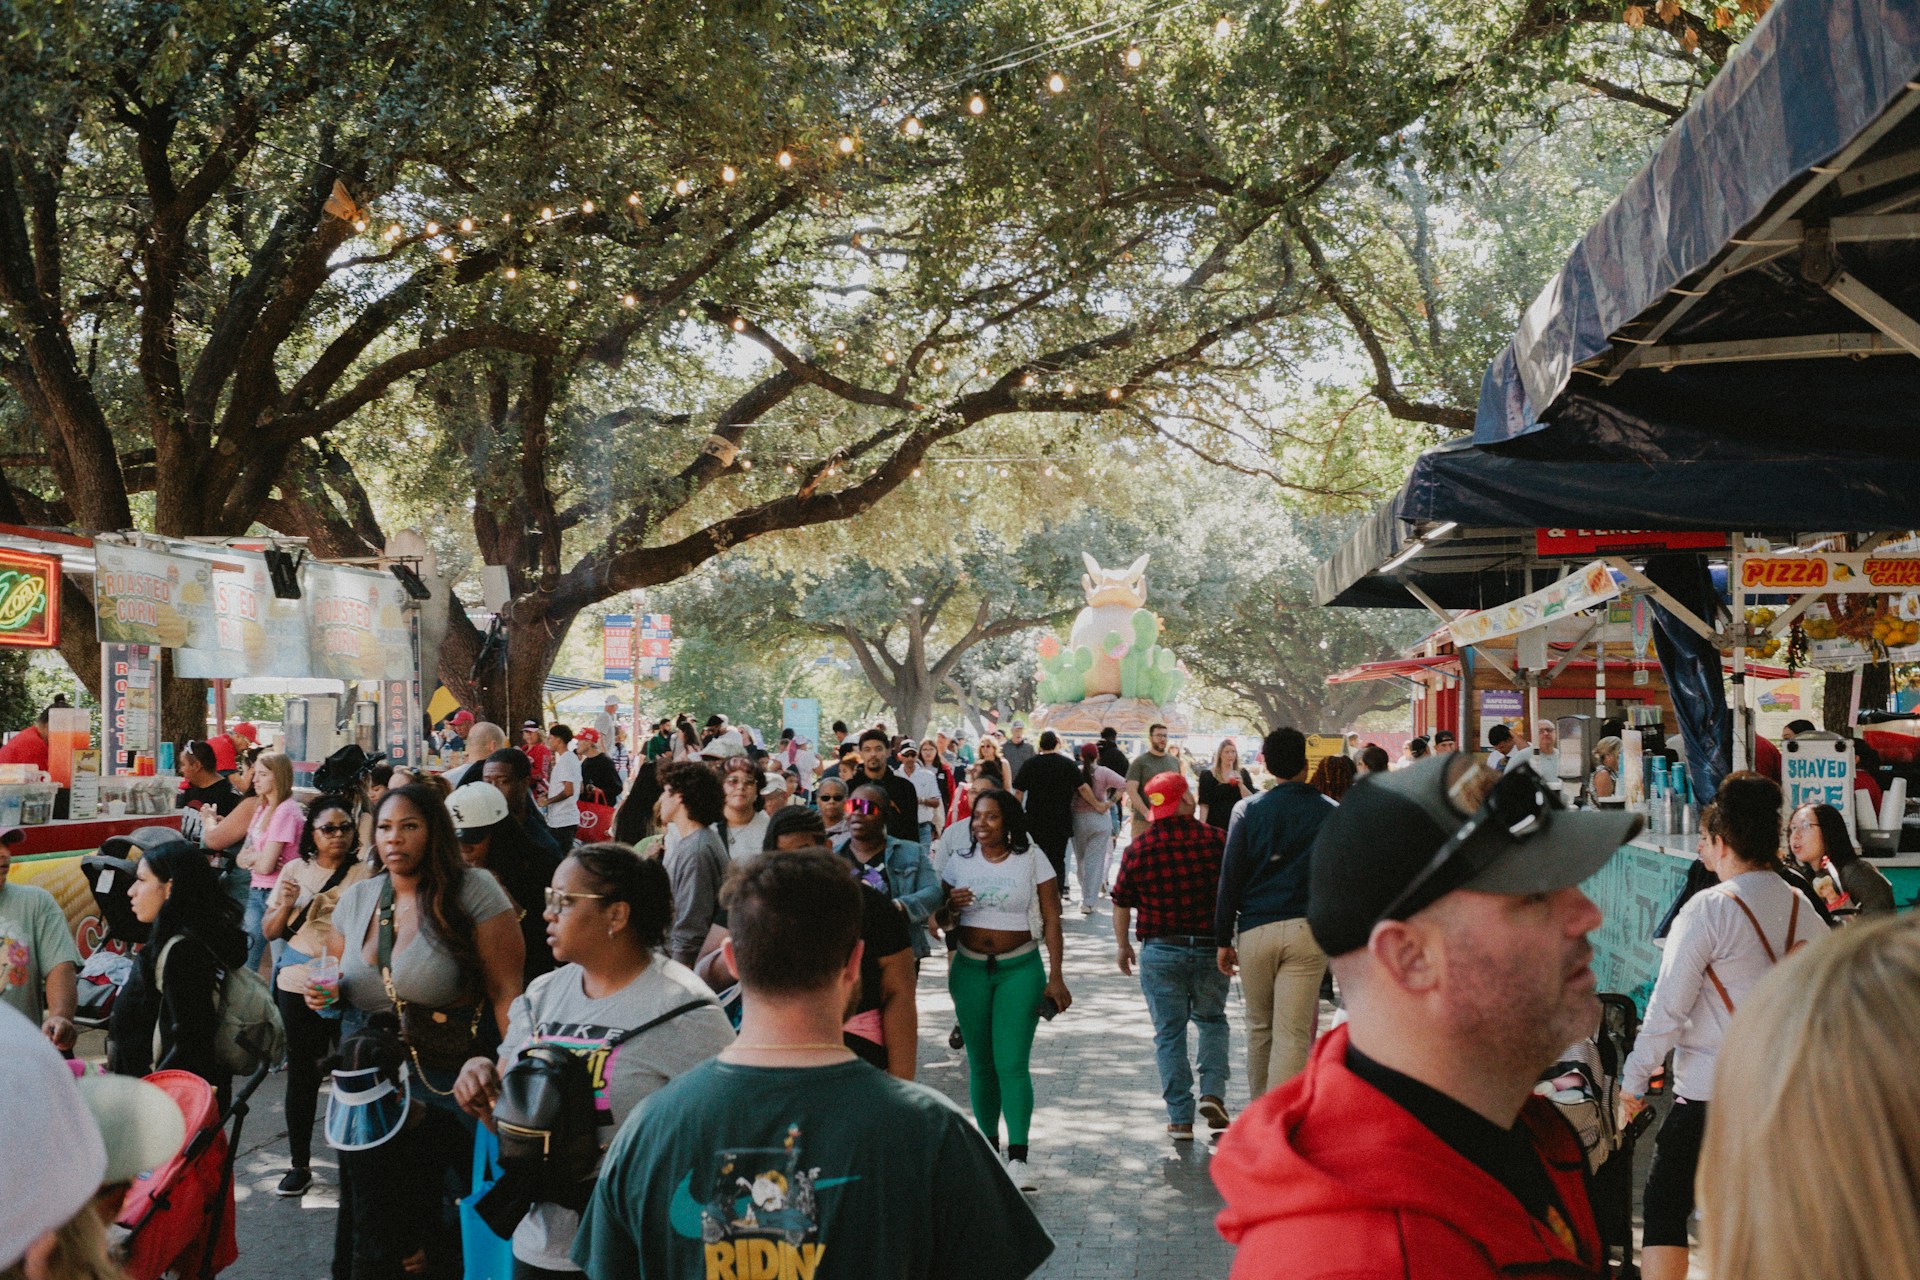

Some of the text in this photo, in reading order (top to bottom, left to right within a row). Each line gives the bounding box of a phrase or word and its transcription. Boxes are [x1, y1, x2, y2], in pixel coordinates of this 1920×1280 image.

[1745, 561, 1826, 584] PIZZA
[105, 572, 171, 603] ROASTED
[117, 599, 158, 627] CORN
[315, 597, 371, 630] ROASTED
[324, 628, 360, 657] CORN
[391, 682, 404, 758] OASTED
[1788, 759, 1846, 779] SHAVED
[1790, 784, 1844, 811] ICE
